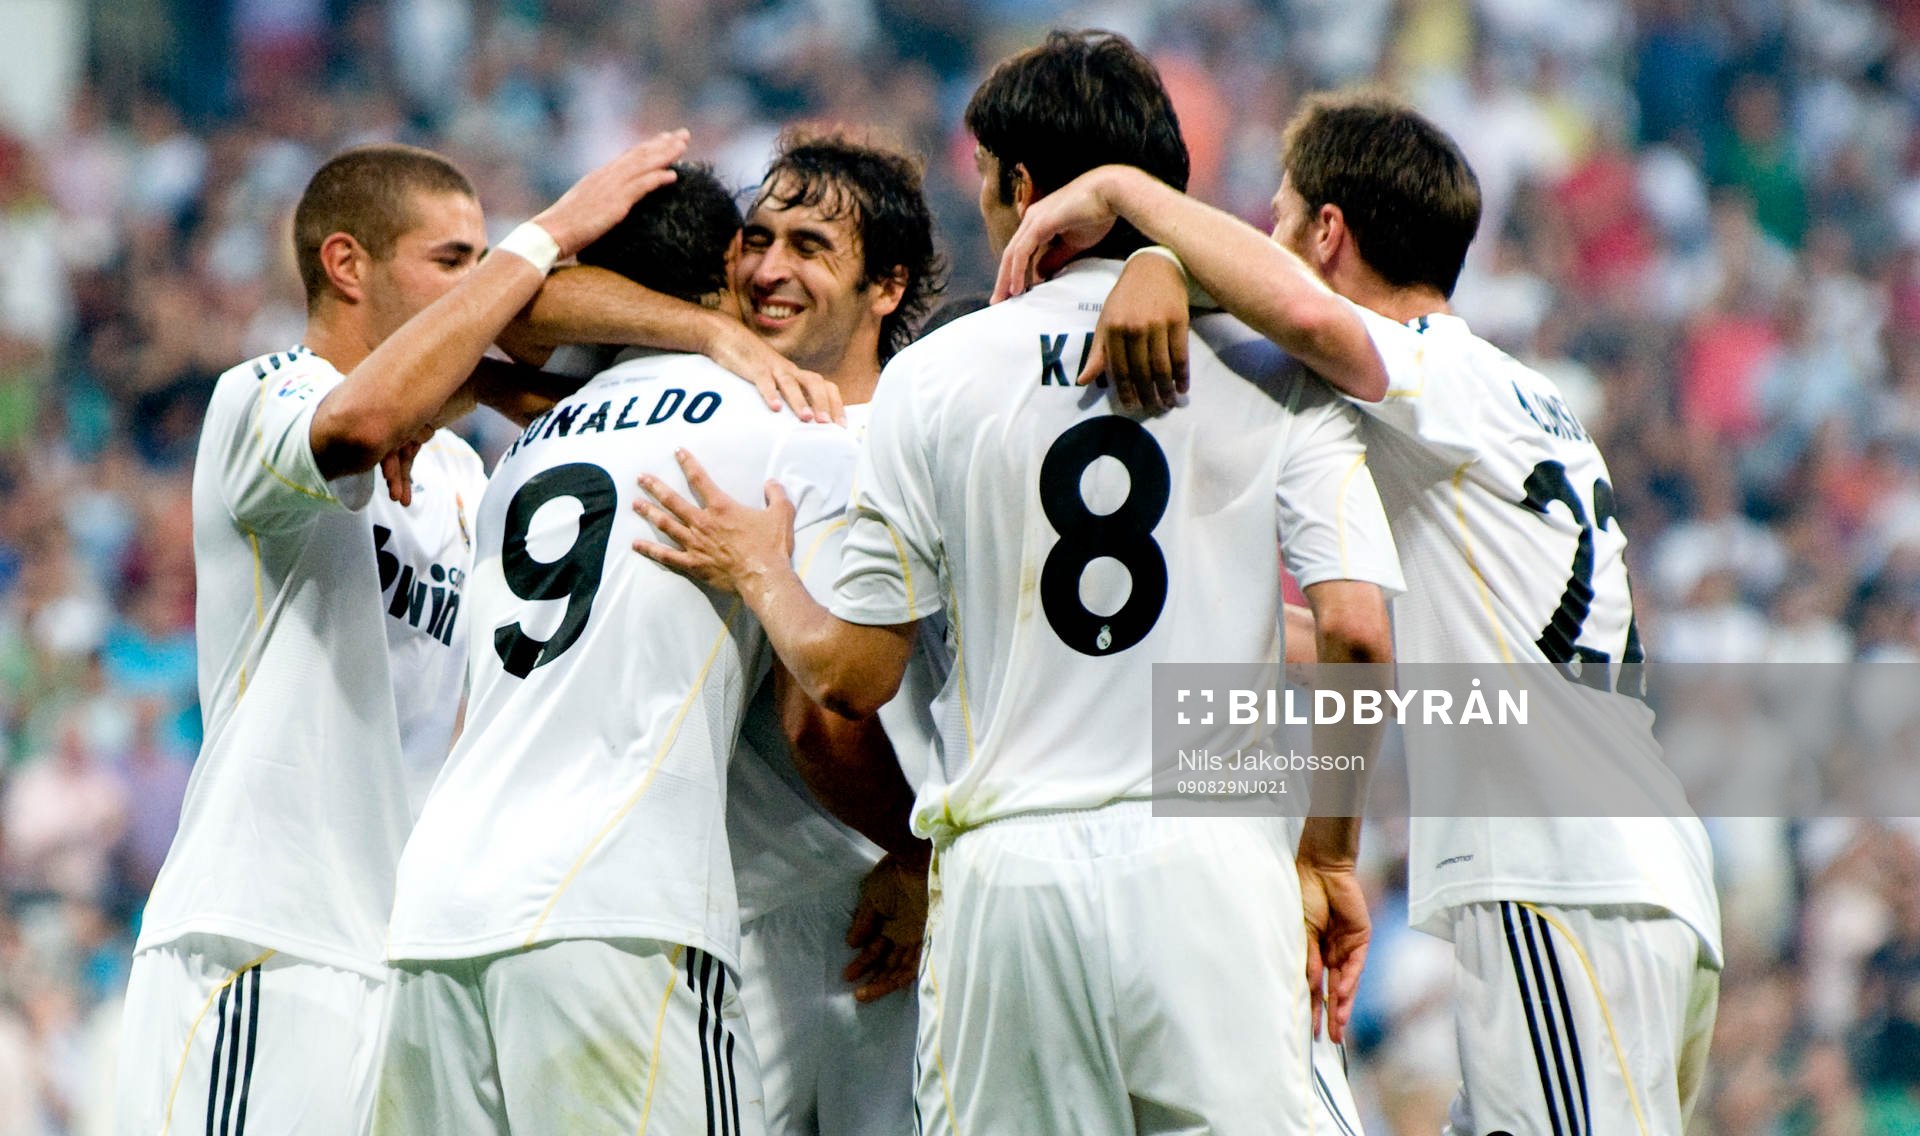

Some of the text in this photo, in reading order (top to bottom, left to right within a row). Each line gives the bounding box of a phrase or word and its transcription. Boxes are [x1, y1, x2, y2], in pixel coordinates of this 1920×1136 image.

[373, 524, 460, 647] bwin
[494, 462, 618, 681] 9
[1040, 414, 1171, 657] 8
